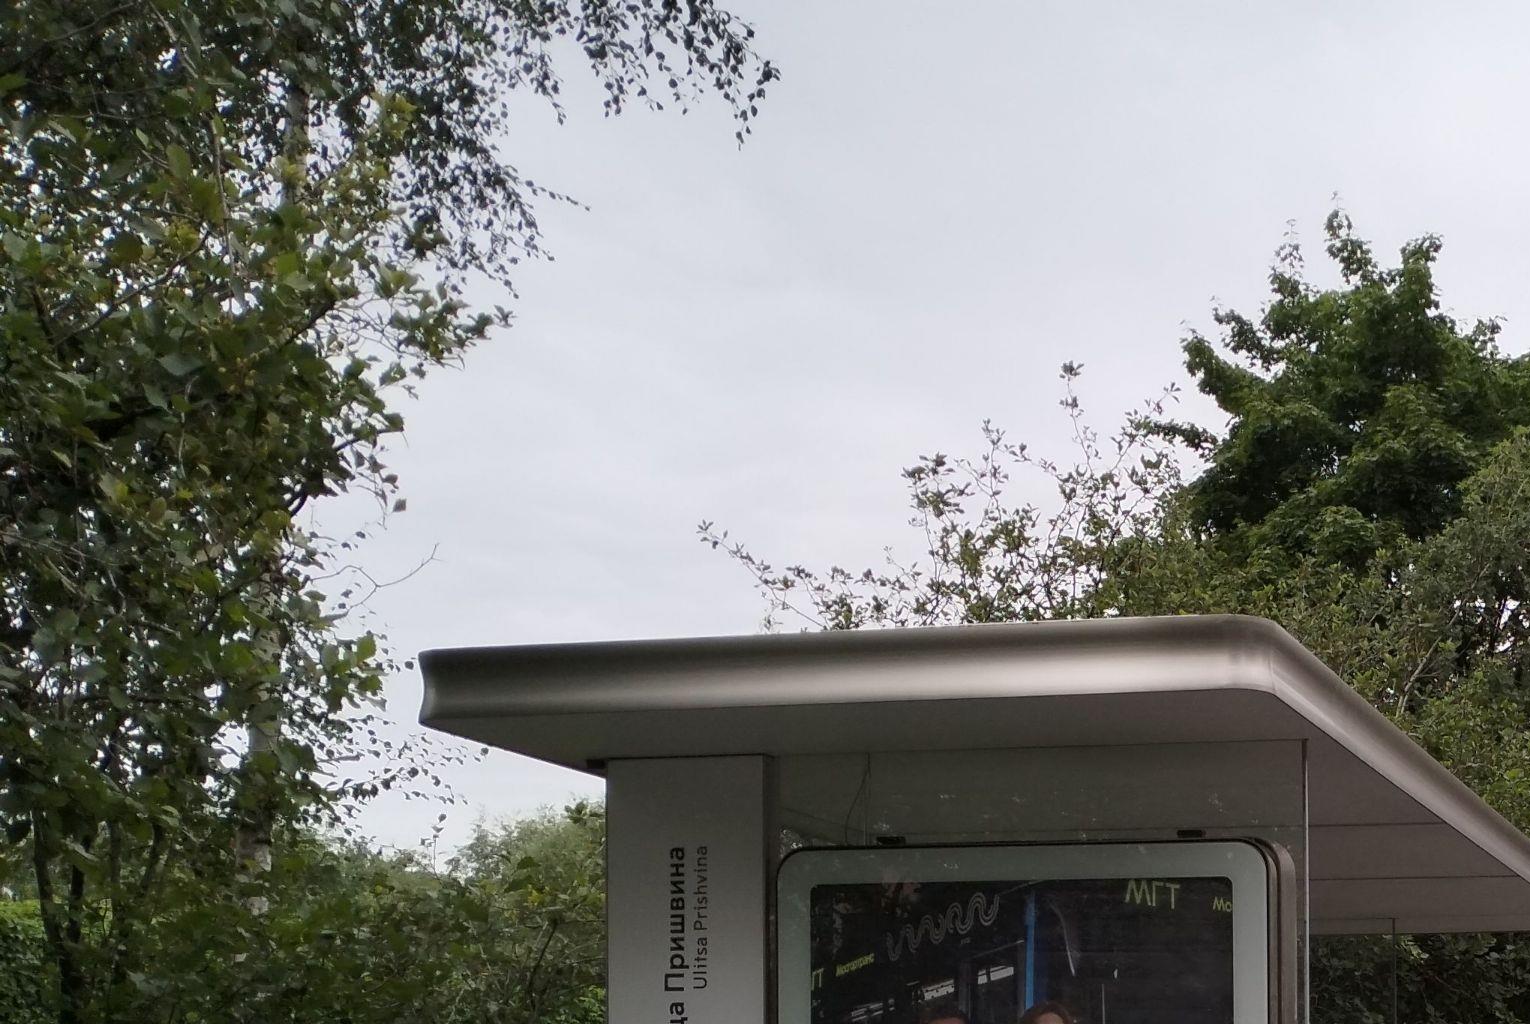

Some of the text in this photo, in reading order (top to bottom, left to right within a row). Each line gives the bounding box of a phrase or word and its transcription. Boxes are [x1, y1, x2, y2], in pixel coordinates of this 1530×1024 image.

[664, 847, 689, 992] Пришвина
[693, 846, 707, 989] Ulitsa Prishvina
[1125, 879, 1180, 910] МГТ
